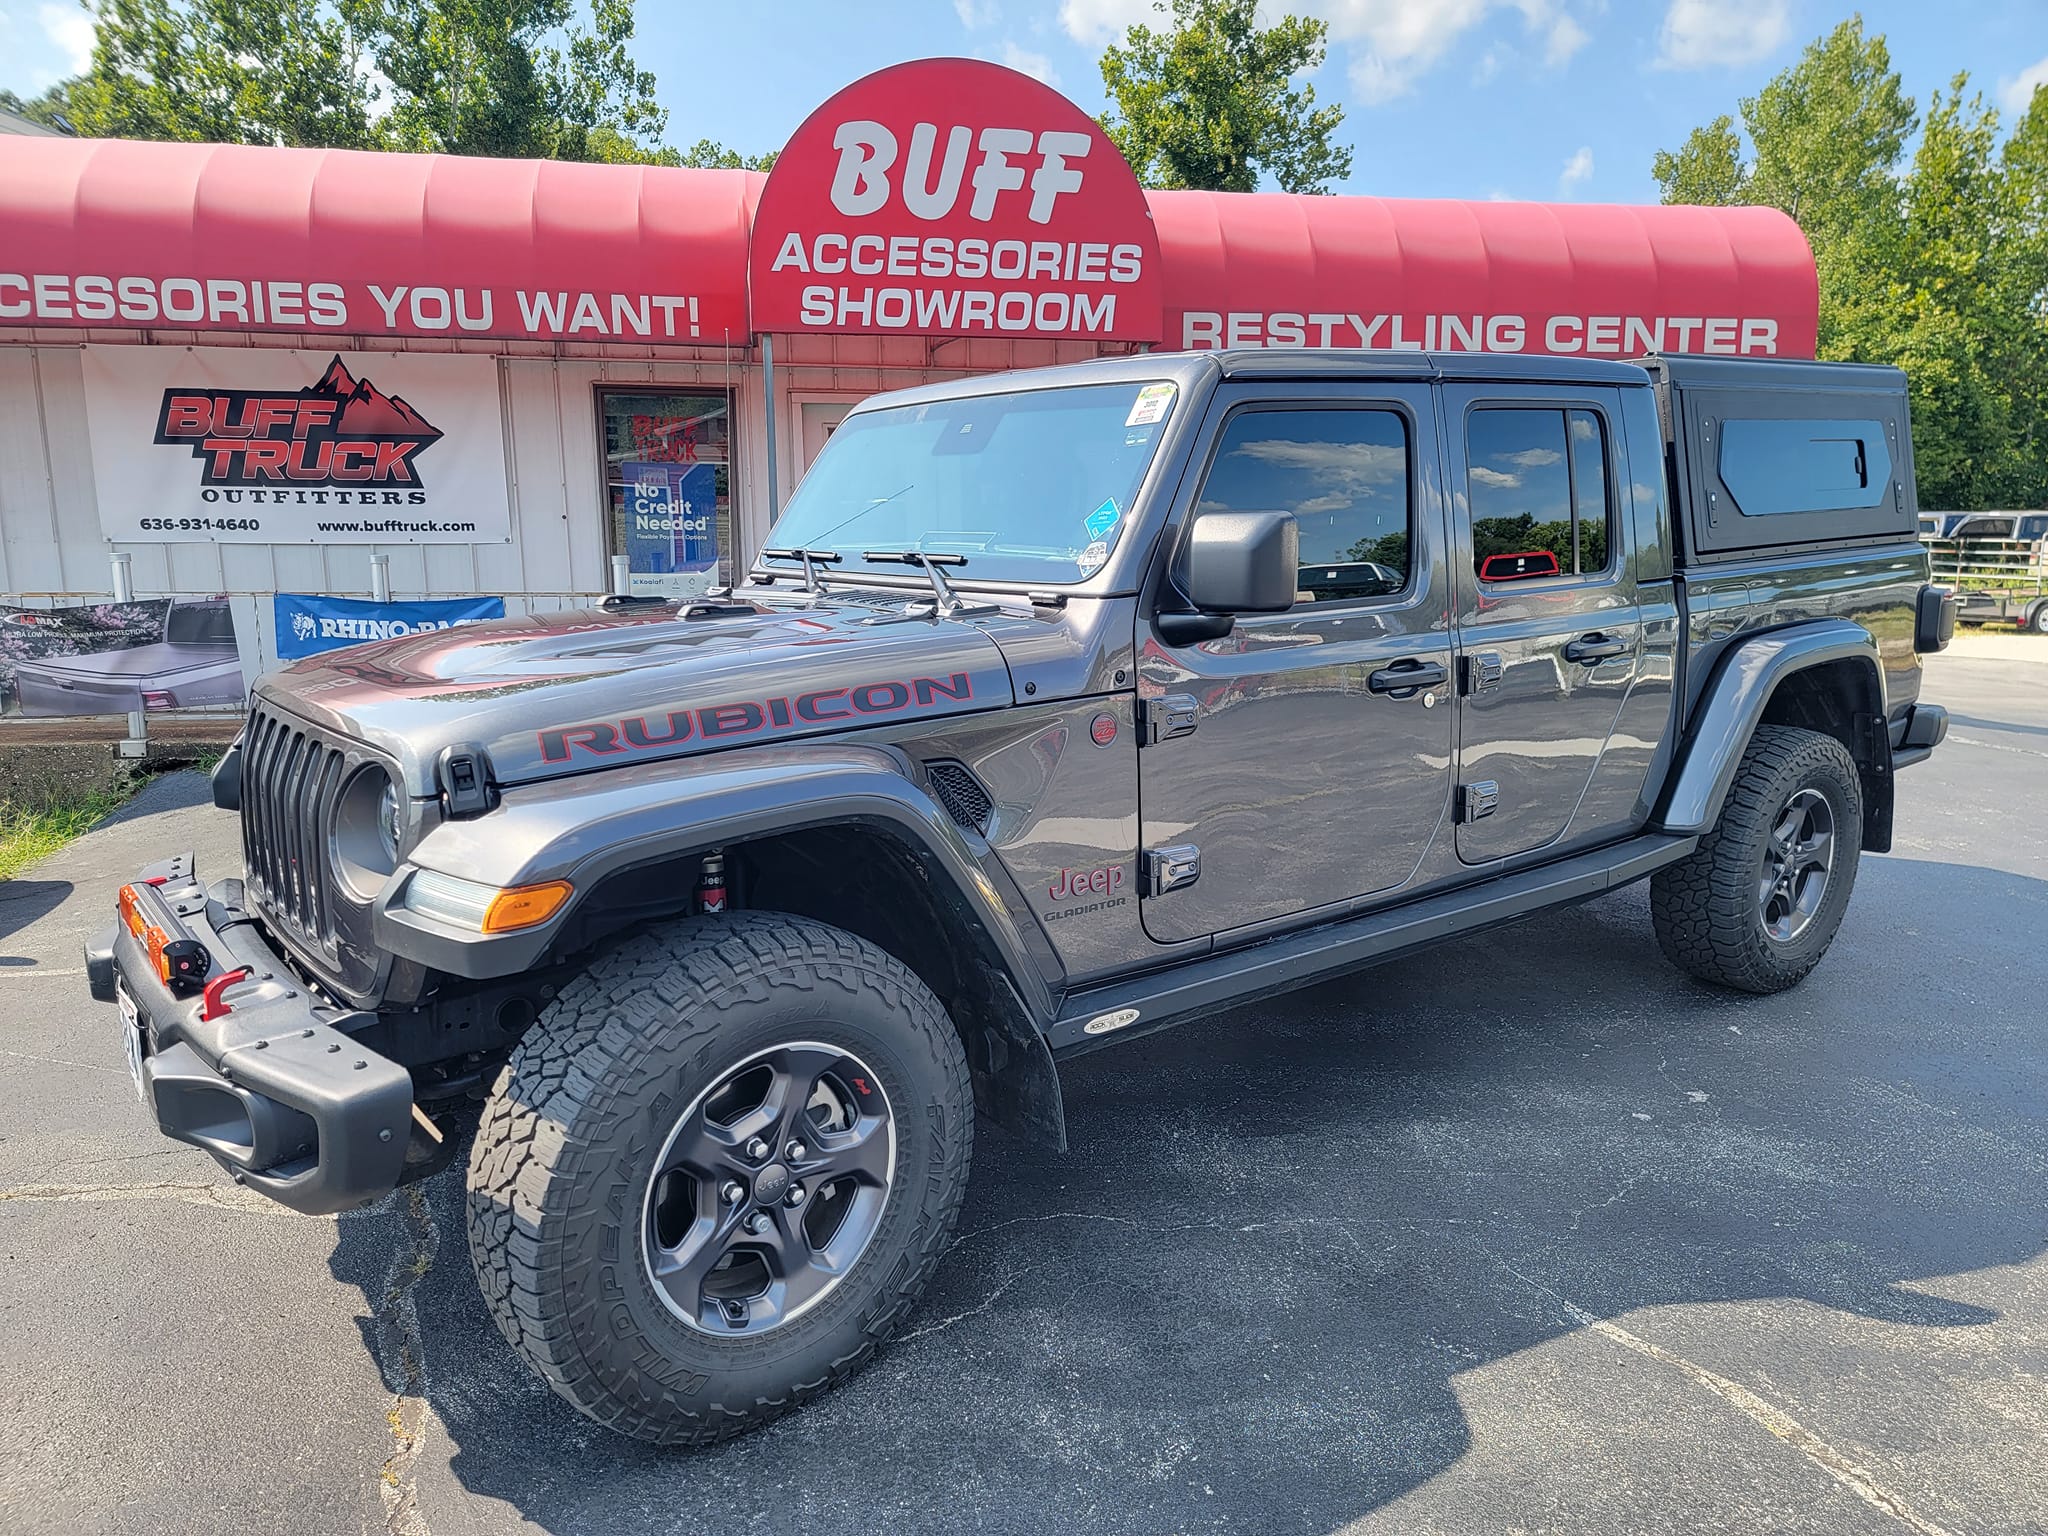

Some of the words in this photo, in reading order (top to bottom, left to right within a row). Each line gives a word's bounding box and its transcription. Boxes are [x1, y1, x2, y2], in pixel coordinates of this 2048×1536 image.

[830, 120, 1092, 224] BUFF
[771, 232, 1143, 283] ACCESSORIES
[366, 285, 494, 331] YOU
[516, 290, 700, 338] WANT!
[800, 285, 1118, 332] SHOWROOM
[1182, 311, 1526, 352] RESTYLING
[1545, 315, 1779, 355] CENTER
[164, 396, 338, 439] BUFF
[632, 414, 699, 438] BUFF
[202, 438, 420, 482] TRUCK
[635, 439, 698, 462] TRUCK
[200, 488, 427, 505] OUTFITTERS
[634, 482, 659, 498] No
[634, 498, 692, 515] Credit
[140, 518, 260, 532] 636-931-4640
[317, 519, 476, 532] www.bufftruck.com
[639, 578, 664, 586] Koalafi
[104, 628, 147, 637] PROTECTION
[537, 671, 974, 765] RUBICON
[1049, 864, 1126, 901] Jeep
[1043, 897, 1127, 923] GLADIATOR
[598, 1132, 711, 1397] WILDPEAK
